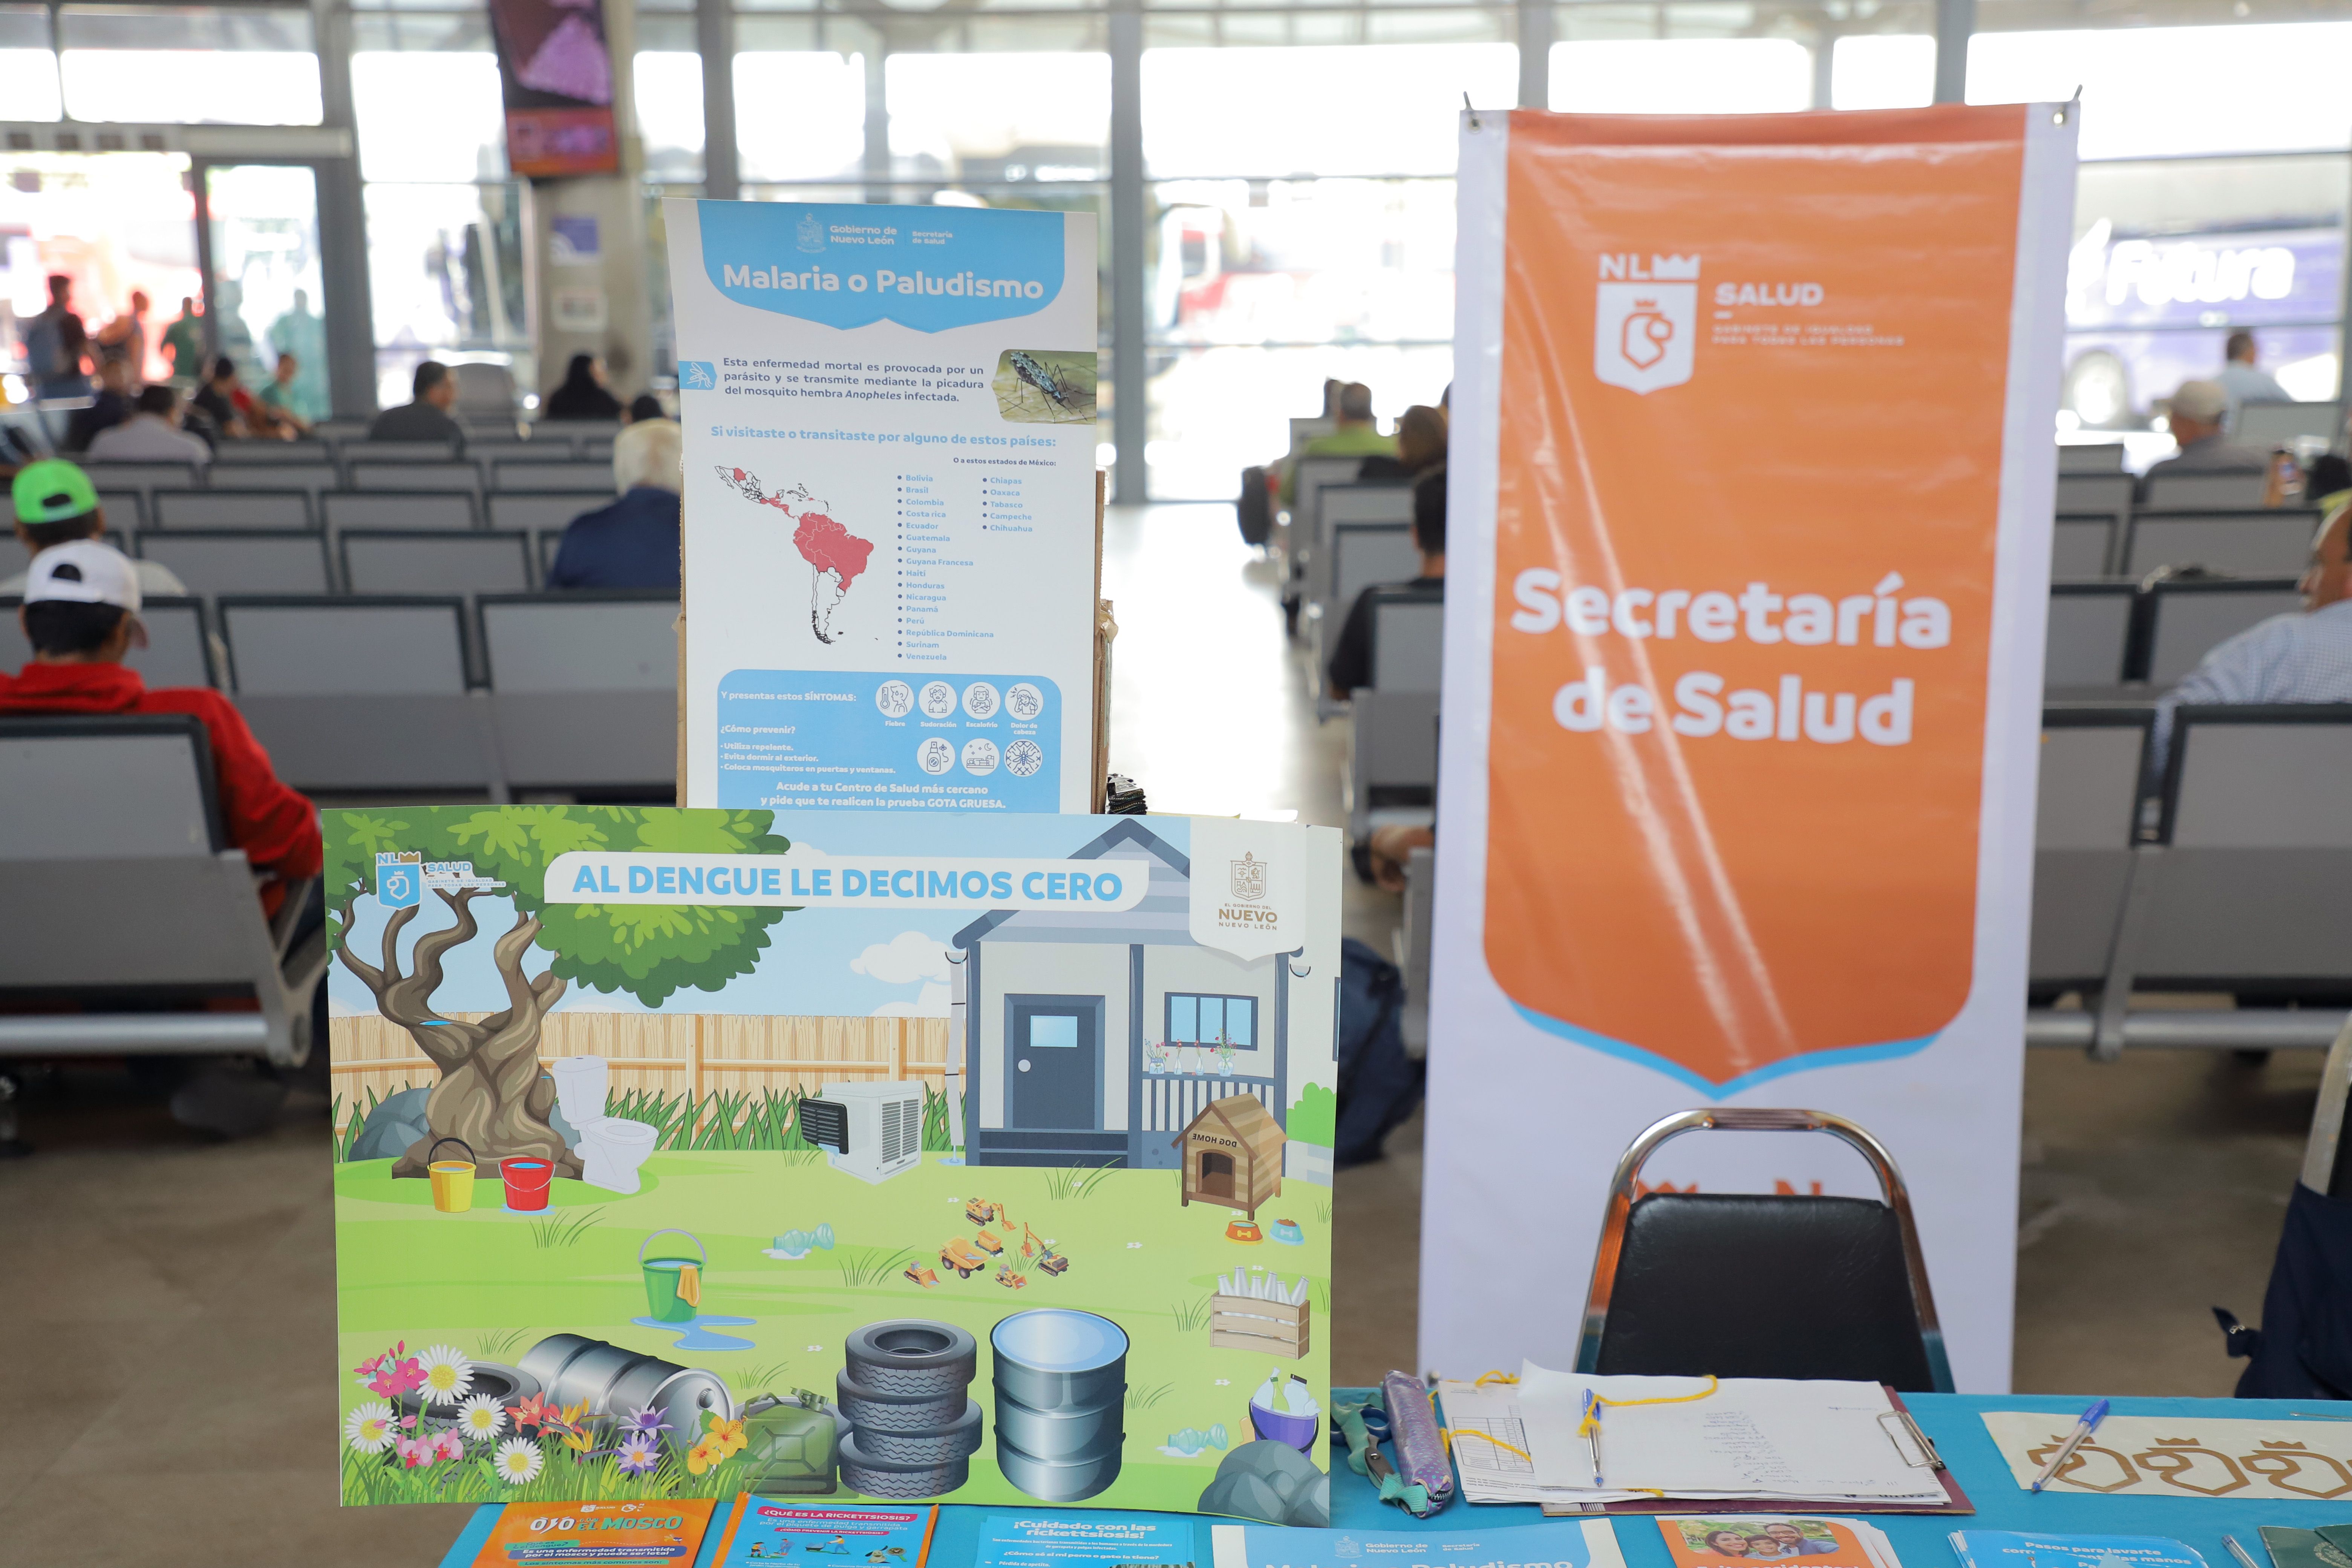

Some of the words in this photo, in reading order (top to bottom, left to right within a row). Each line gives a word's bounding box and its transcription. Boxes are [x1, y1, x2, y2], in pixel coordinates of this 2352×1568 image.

[830, 225, 880, 234] Gobierno
[868, 236, 894, 244] León
[1602, 255, 1651, 279] NL
[724, 265, 839, 291] Malaria
[848, 275, 867, 292] o
[877, 271, 1043, 299] Paludismo
[1715, 284, 1824, 306] SALUD
[724, 358, 747, 366] Esta
[753, 360, 819, 369] enfermedad
[724, 372, 770, 382] parásito
[775, 375, 781, 384] y
[804, 375, 859, 384] transmite
[864, 377, 917, 386] mediante
[937, 379, 983, 389] picadura
[725, 386, 741, 394] del
[744, 387, 797, 397] mosquito
[801, 389, 842, 397] hembra
[845, 390, 901, 400] Anopheles
[905, 391, 959, 401] infectada.
[711, 426, 723, 436] Si
[726, 426, 785, 438] visitaste
[799, 430, 875, 441] transitaste
[878, 434, 900, 443] por
[903, 433, 948, 445] alguno
[951, 434, 966, 444] de
[970, 436, 1007, 445] estos
[1010, 435, 1055, 447] países:
[906, 594, 946, 602] Nicaragua
[1512, 568, 1950, 648] Secretaría
[804, 692, 856, 701] SÍNTOMAS:
[1554, 665, 1653, 733] de
[1673, 671, 1914, 746] Salud
[720, 724, 751, 733] ¿Cómo
[753, 726, 795, 734] prevenir?
[776, 782, 810, 791] Acude
[835, 783, 871, 792] Centro
[874, 784, 887, 792] de
[890, 784, 919, 793] Salud
[922, 784, 944, 793] más
[761, 798, 767, 806] y
[770, 796, 793, 806] pide
[795, 798, 815, 807] que
[831, 797, 873, 806] realicen
[876, 798, 885, 806] la
[888, 798, 925, 808] prueba
[927, 799, 957, 807] GOTA
[959, 799, 1006, 808] GRUESA.
[378, 854, 399, 864] NL
[427, 862, 471, 872] SALUD
[572, 865, 620, 893] AL
[628, 866, 781, 895] DENGUE
[791, 869, 831, 896] LE
[842, 870, 1012, 899] DECIMOS
[1022, 872, 1122, 901] CERO
[1219, 909, 1277, 923] NUEVO
[577, 1522, 597, 1530] EL
[601, 1516, 683, 1530] MOSCO
[1014, 1521, 1092, 1530] ¡Cuidado
[1026, 1528, 1144, 1539] rickettsiosis!
[2025, 1542, 2069, 1551] Pasos
